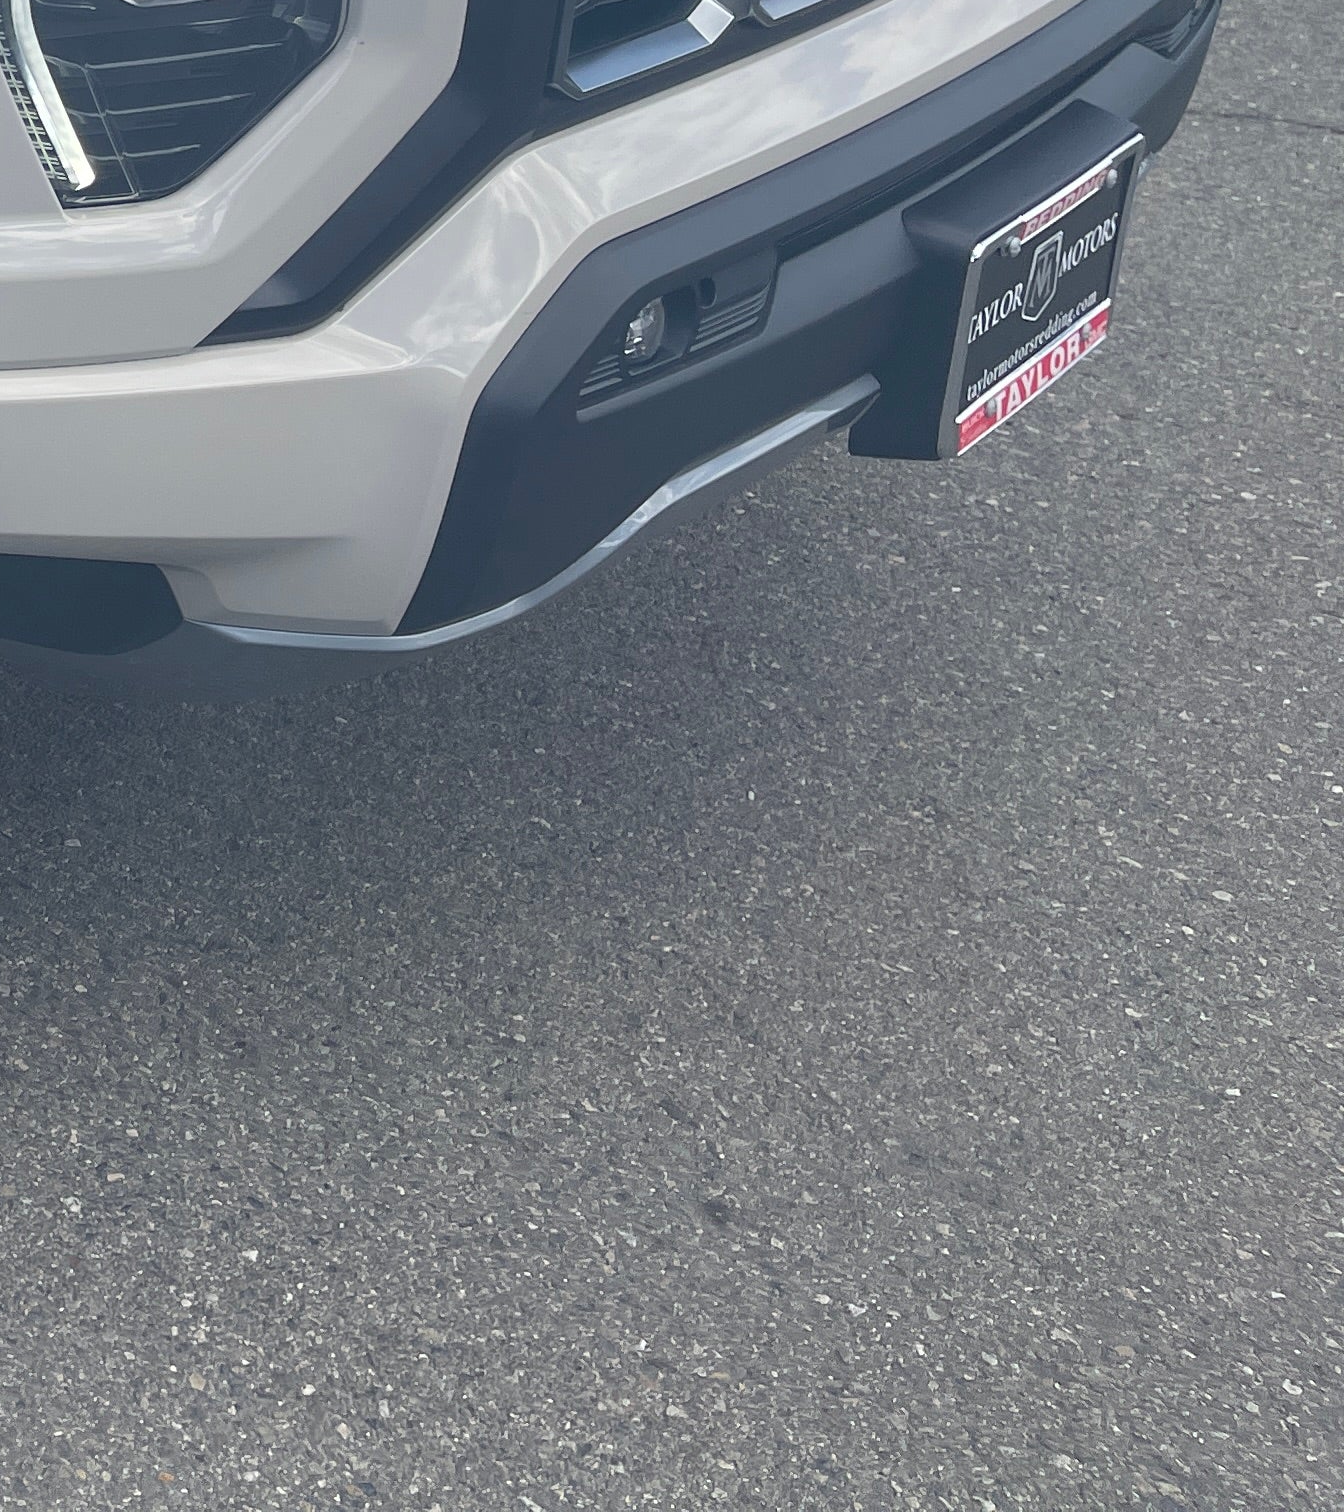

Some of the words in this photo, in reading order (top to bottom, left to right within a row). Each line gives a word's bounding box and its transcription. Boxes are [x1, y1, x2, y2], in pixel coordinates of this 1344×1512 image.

[967, 283, 1024, 345] TAYLOR
[1058, 212, 1119, 278] MOTORS
[967, 291, 1097, 402] taylormotorsredding.com
[995, 332, 1083, 423] TAYLOR
